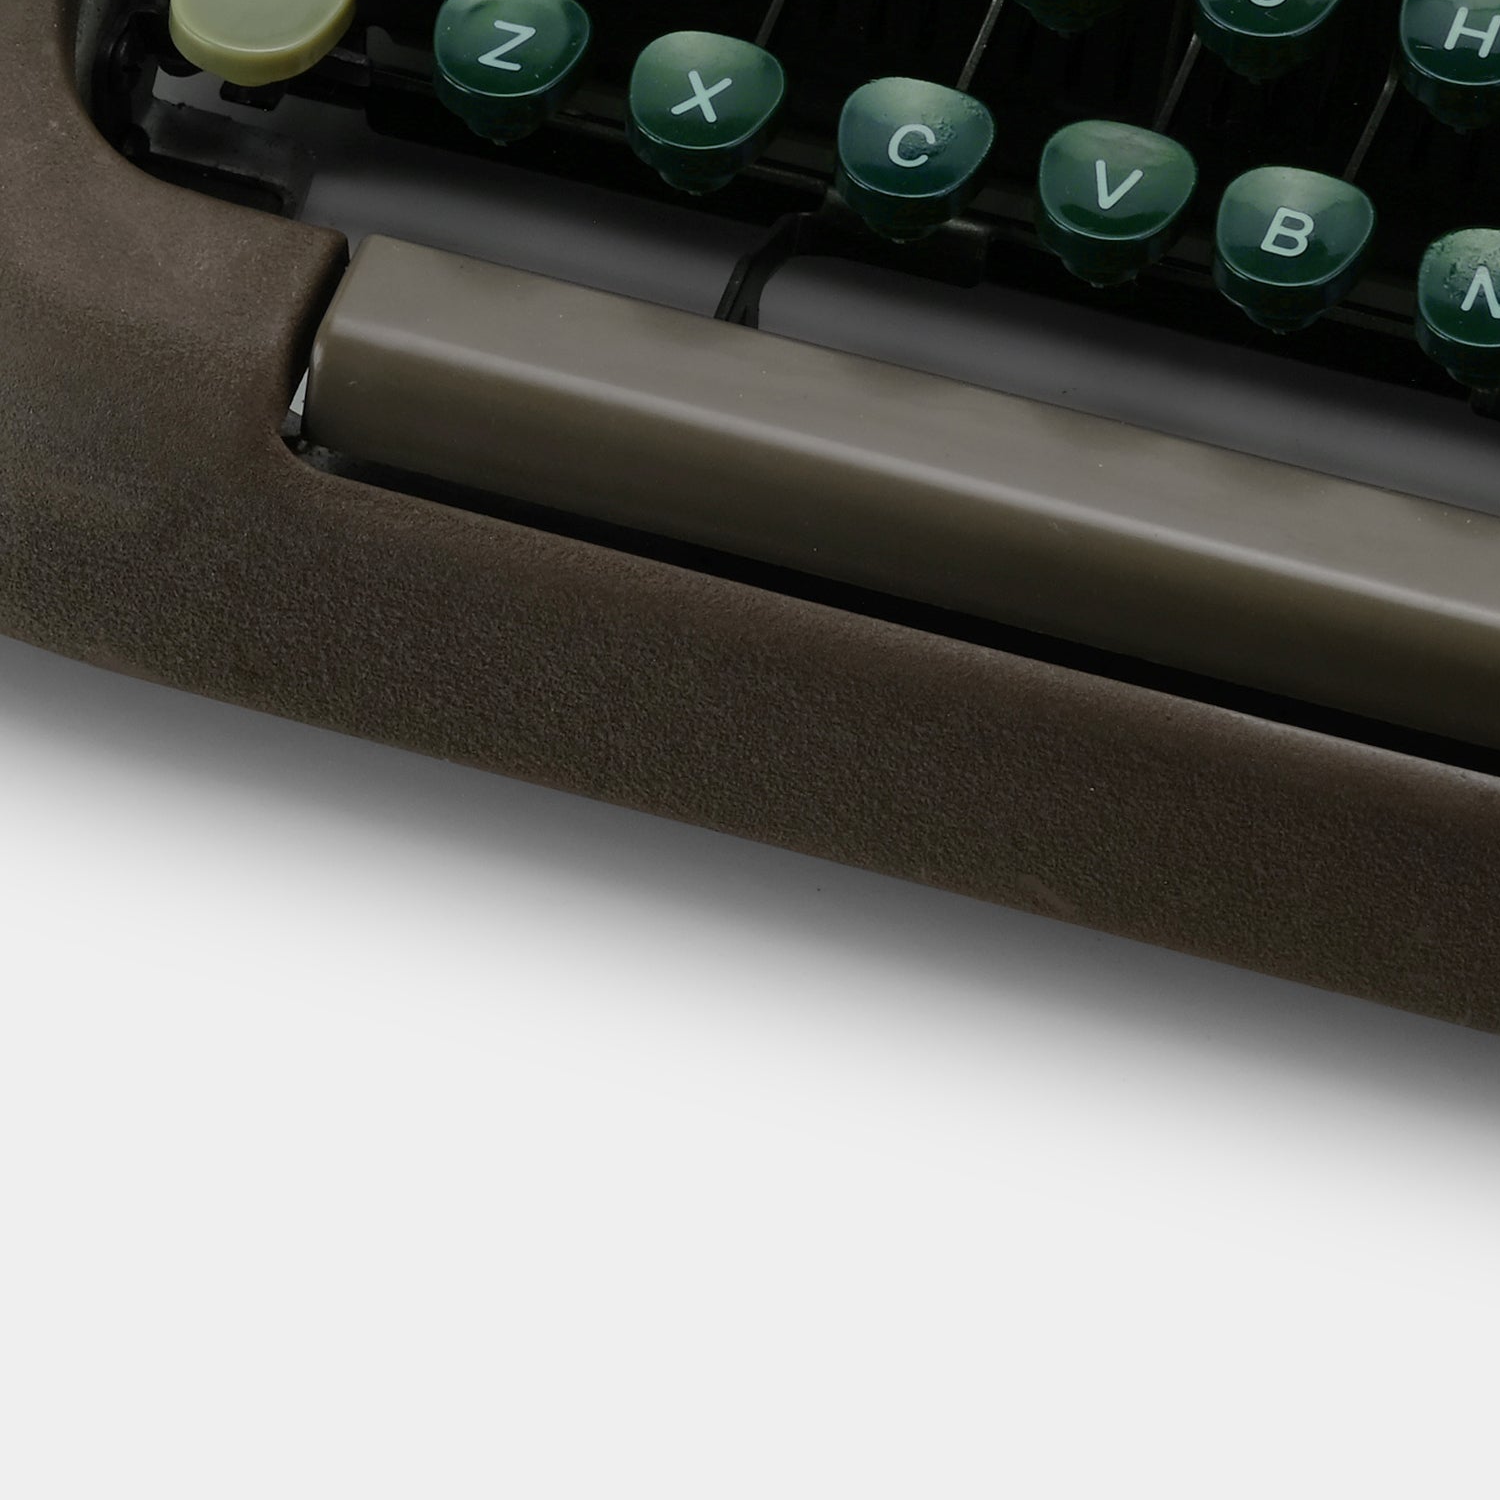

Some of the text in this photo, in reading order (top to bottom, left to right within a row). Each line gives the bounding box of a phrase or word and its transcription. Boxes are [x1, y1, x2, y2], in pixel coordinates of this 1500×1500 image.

[477, 19, 536, 71] Z
[670, 68, 733, 123] X
[887, 119, 941, 168] C
[1095, 159, 1144, 210] V
[1260, 203, 1318, 257] B
